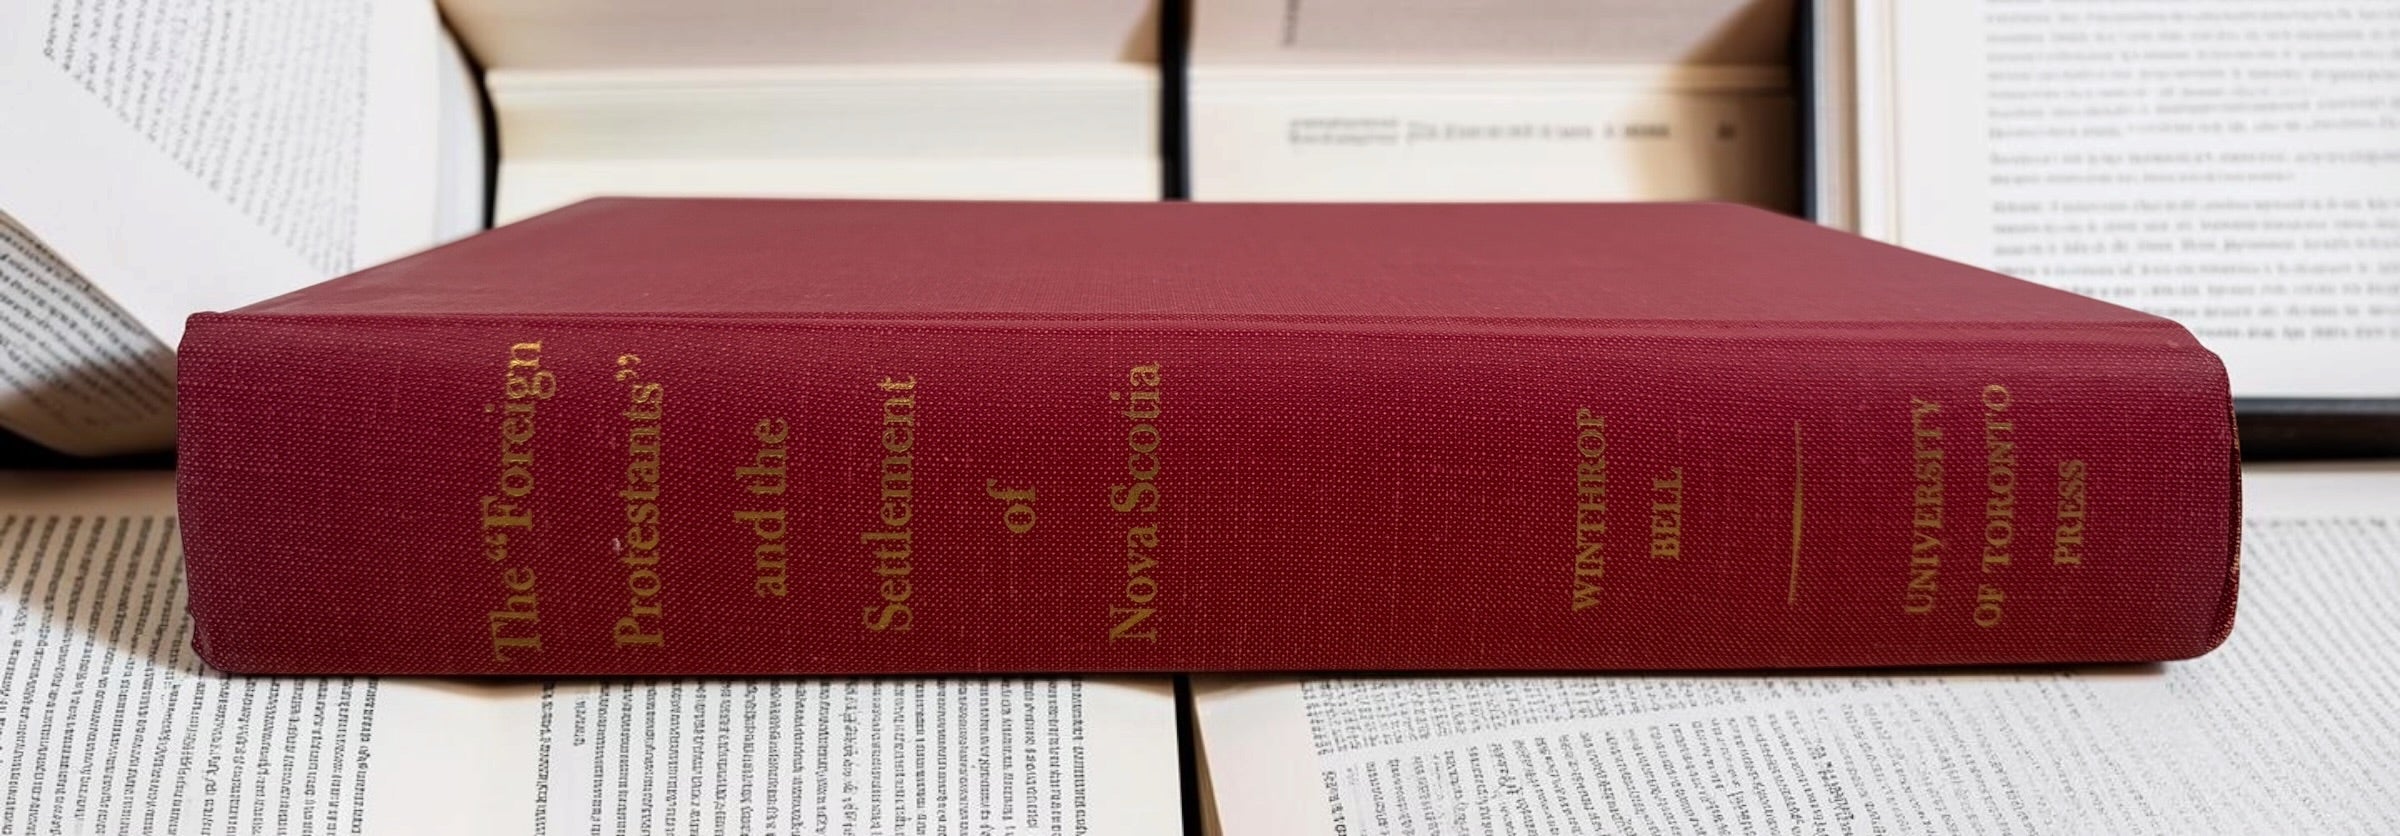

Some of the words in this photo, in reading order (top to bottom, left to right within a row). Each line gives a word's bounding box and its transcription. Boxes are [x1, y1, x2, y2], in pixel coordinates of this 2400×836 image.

[734, 416, 790, 496] the
[1109, 361, 1162, 513] Scotia
[1981, 383, 2016, 575] TORONTO
[733, 507, 789, 598] and
[861, 375, 917, 633] Settlement
[986, 478, 1037, 534] of
[1571, 406, 1607, 612] WINTHROP
[1650, 466, 1682, 560] BELL
[1904, 397, 1943, 615] UNIVERSITY
[2052, 458, 2087, 567] PRESS
[488, 563, 543, 664] The
[1109, 522, 1159, 644] Nova
[1972, 581, 2005, 629] OF
